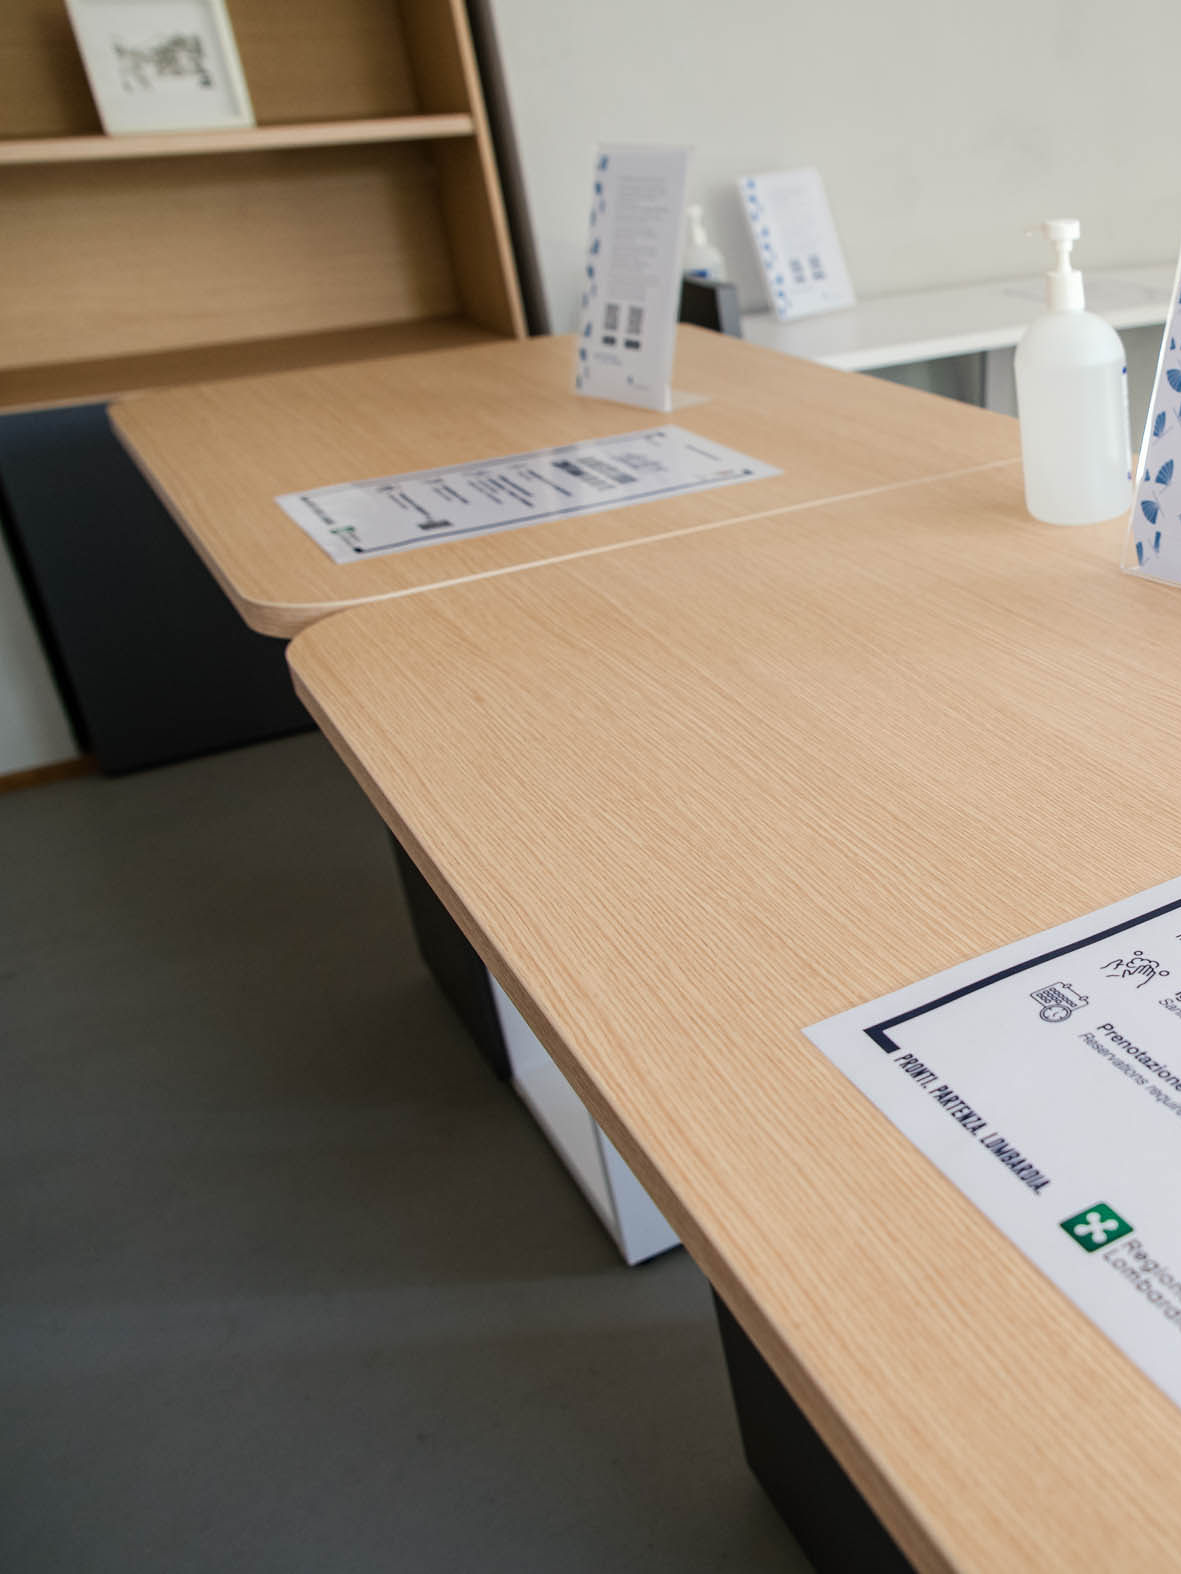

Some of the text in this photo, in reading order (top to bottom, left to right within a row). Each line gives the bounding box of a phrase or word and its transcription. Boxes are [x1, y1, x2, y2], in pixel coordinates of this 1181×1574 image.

[1078, 1031, 1150, 1087] Reservations
[893, 1052, 1052, 1196] PRONTI. PARTENZA. LOMBARDIA.
